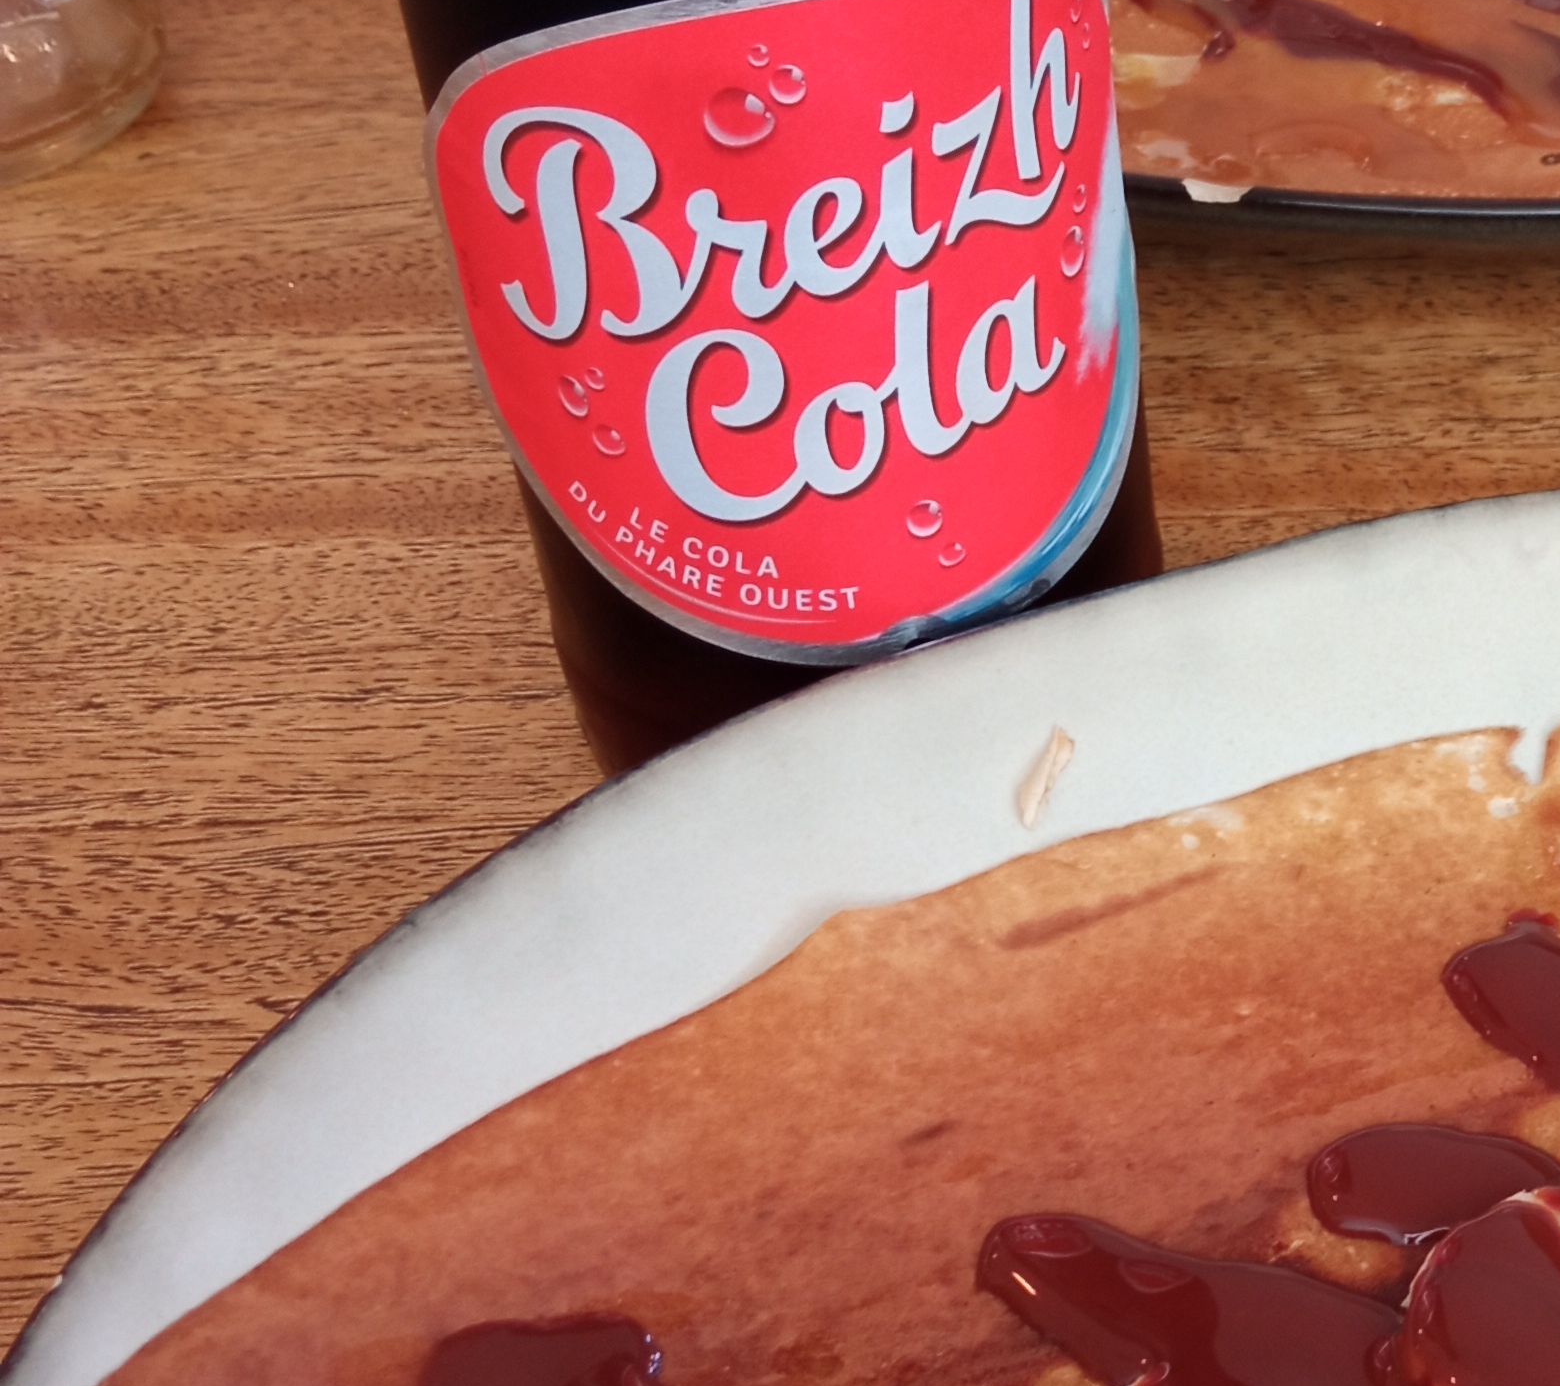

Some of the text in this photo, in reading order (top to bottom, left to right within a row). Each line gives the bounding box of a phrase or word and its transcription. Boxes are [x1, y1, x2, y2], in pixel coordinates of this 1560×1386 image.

[645, 275, 1066, 522] Cola
[568, 480, 860, 612] DU PHARE OUEST
[629, 507, 779, 579] LE COLA
